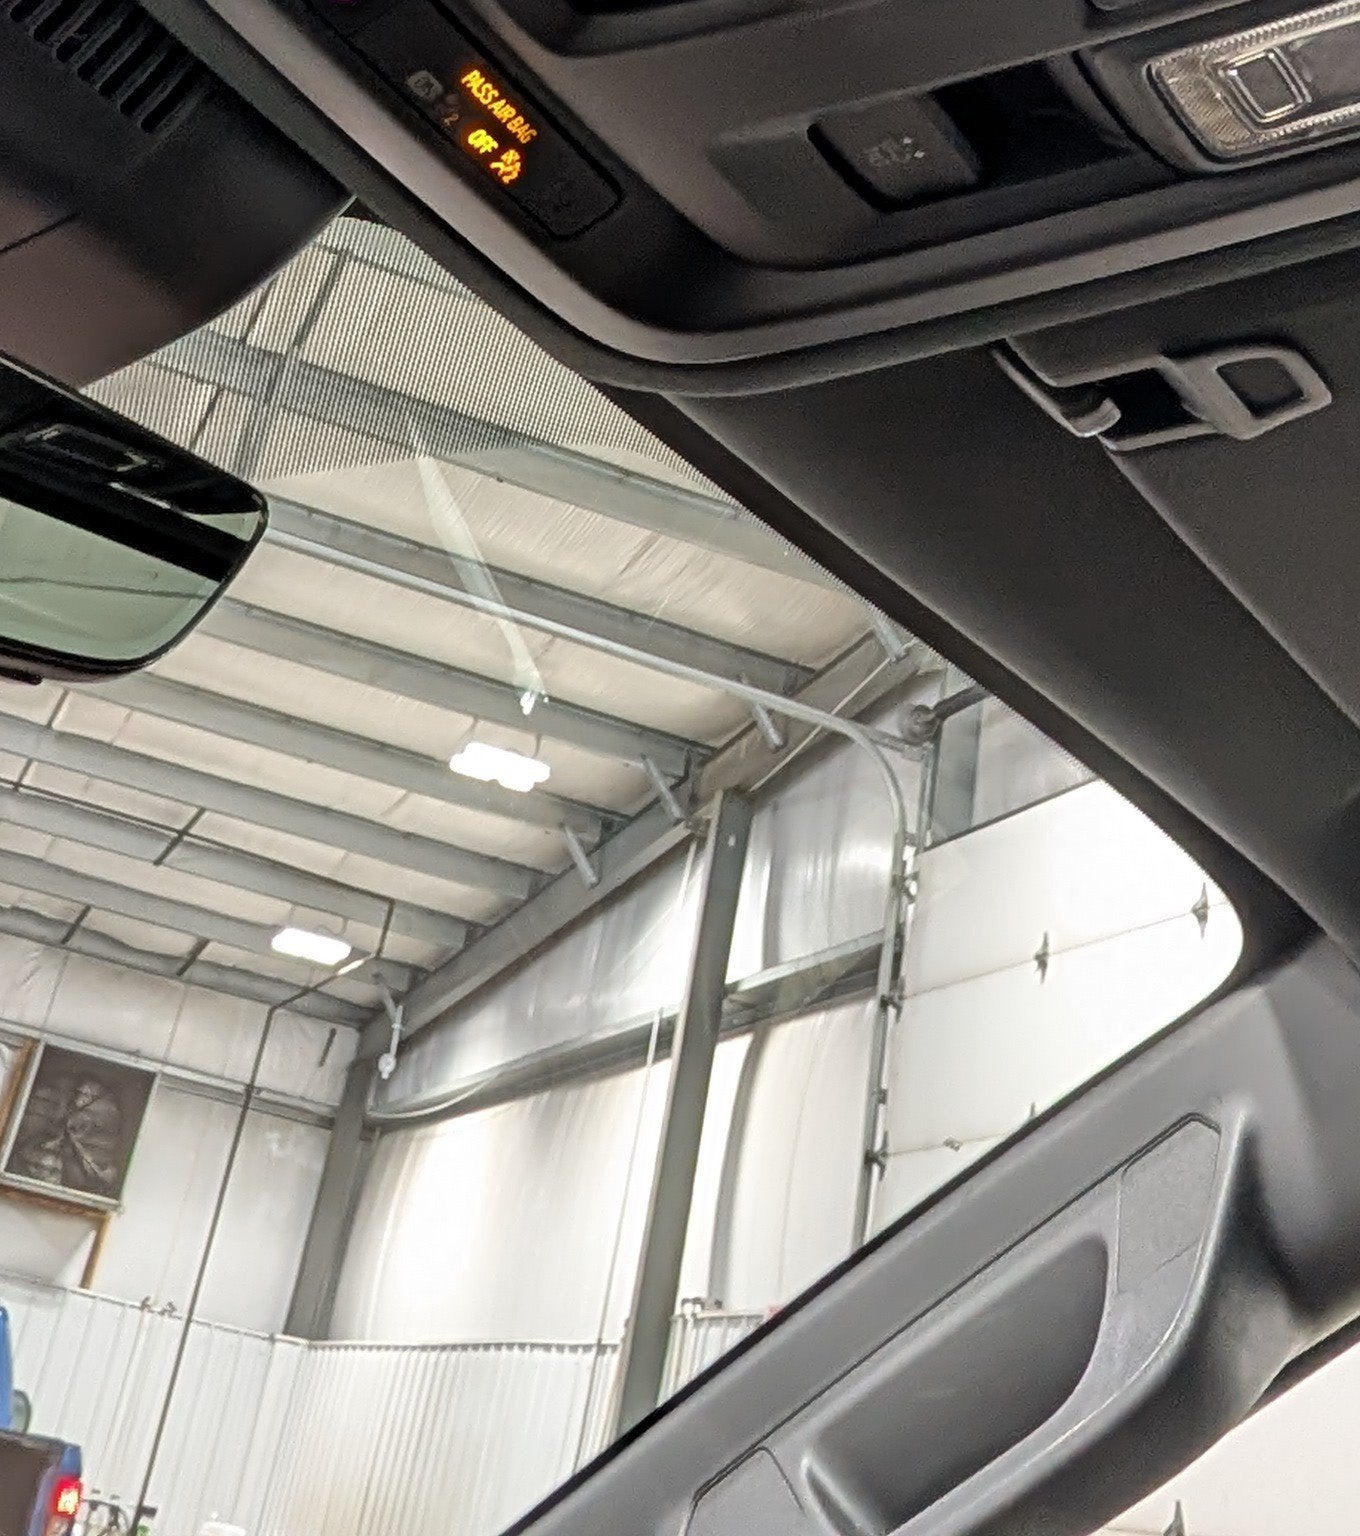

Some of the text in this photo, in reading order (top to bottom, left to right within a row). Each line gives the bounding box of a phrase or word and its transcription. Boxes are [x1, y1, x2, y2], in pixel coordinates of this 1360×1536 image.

[461, 69, 538, 144] PASS AIR BAG
[467, 129, 499, 154] OFF
